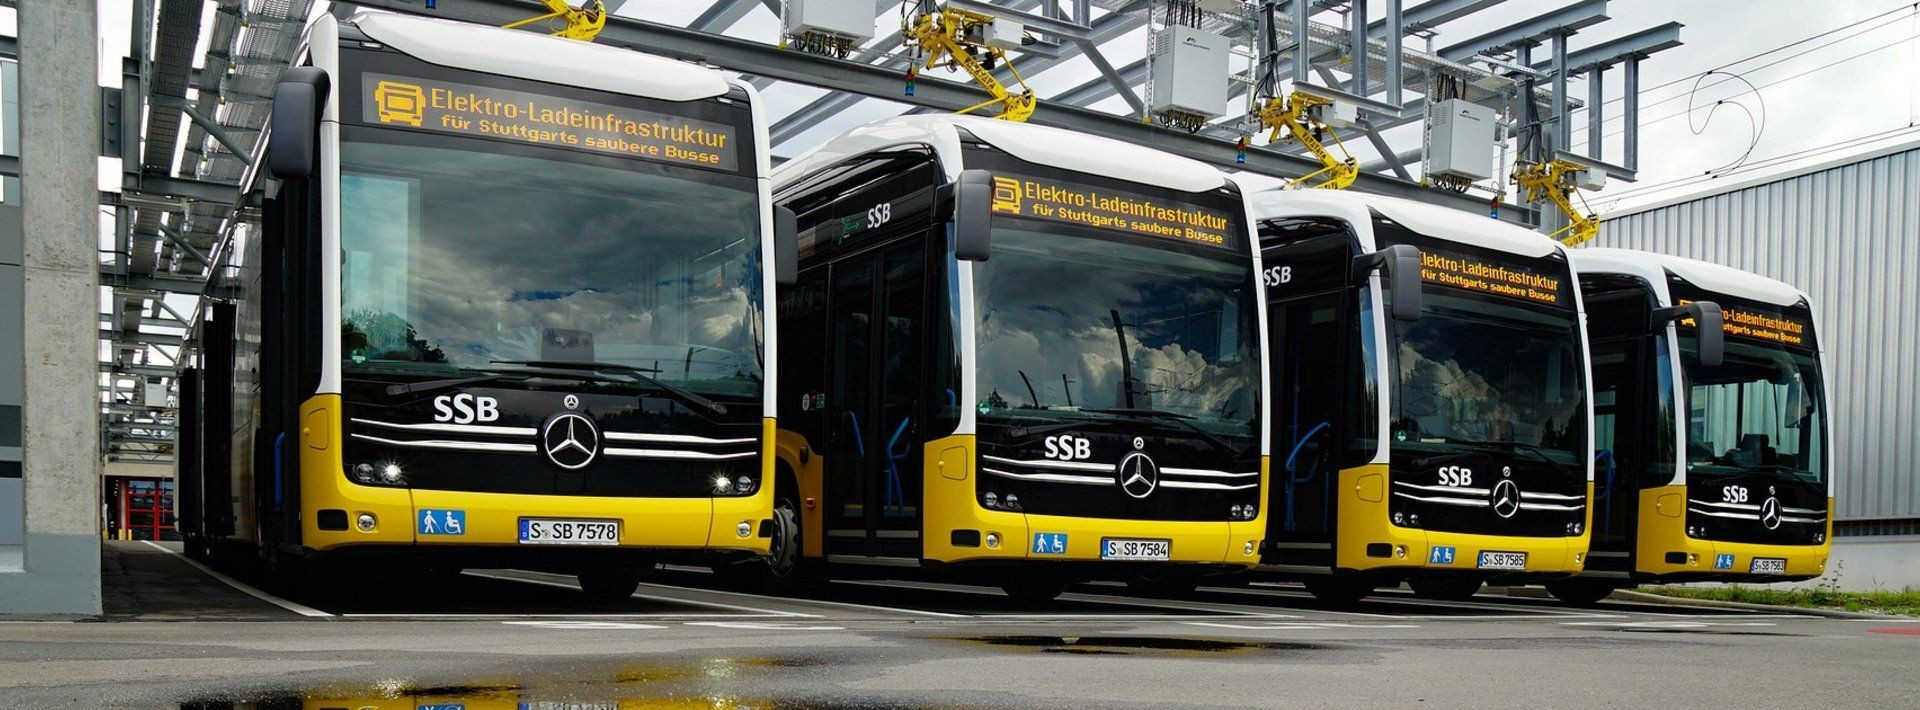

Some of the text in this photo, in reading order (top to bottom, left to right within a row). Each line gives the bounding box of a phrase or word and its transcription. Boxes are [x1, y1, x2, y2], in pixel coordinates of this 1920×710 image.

[431, 88, 727, 149] Elektro-Ladeinfrastruktur
[441, 114, 719, 165] für Stuttgarts saubere Busse
[867, 202, 891, 229] SSB
[1025, 182, 1228, 231] Elektro-Ladeinfrastruktur
[1032, 203, 1224, 245] für Stuttgarts saubere Busse
[1263, 266, 1291, 287] SSB
[1421, 268, 1556, 302] für Stuttgarts saubere Busse
[434, 393, 499, 424] SSB
[1044, 435, 1091, 460] SSB
[1438, 465, 1472, 487] SSB
[1723, 485, 1748, 503] SSB
[531, 523, 616, 540] S SB 7578
[1109, 542, 1167, 556] S SB 7584
[1505, 554, 1524, 566] 7585
